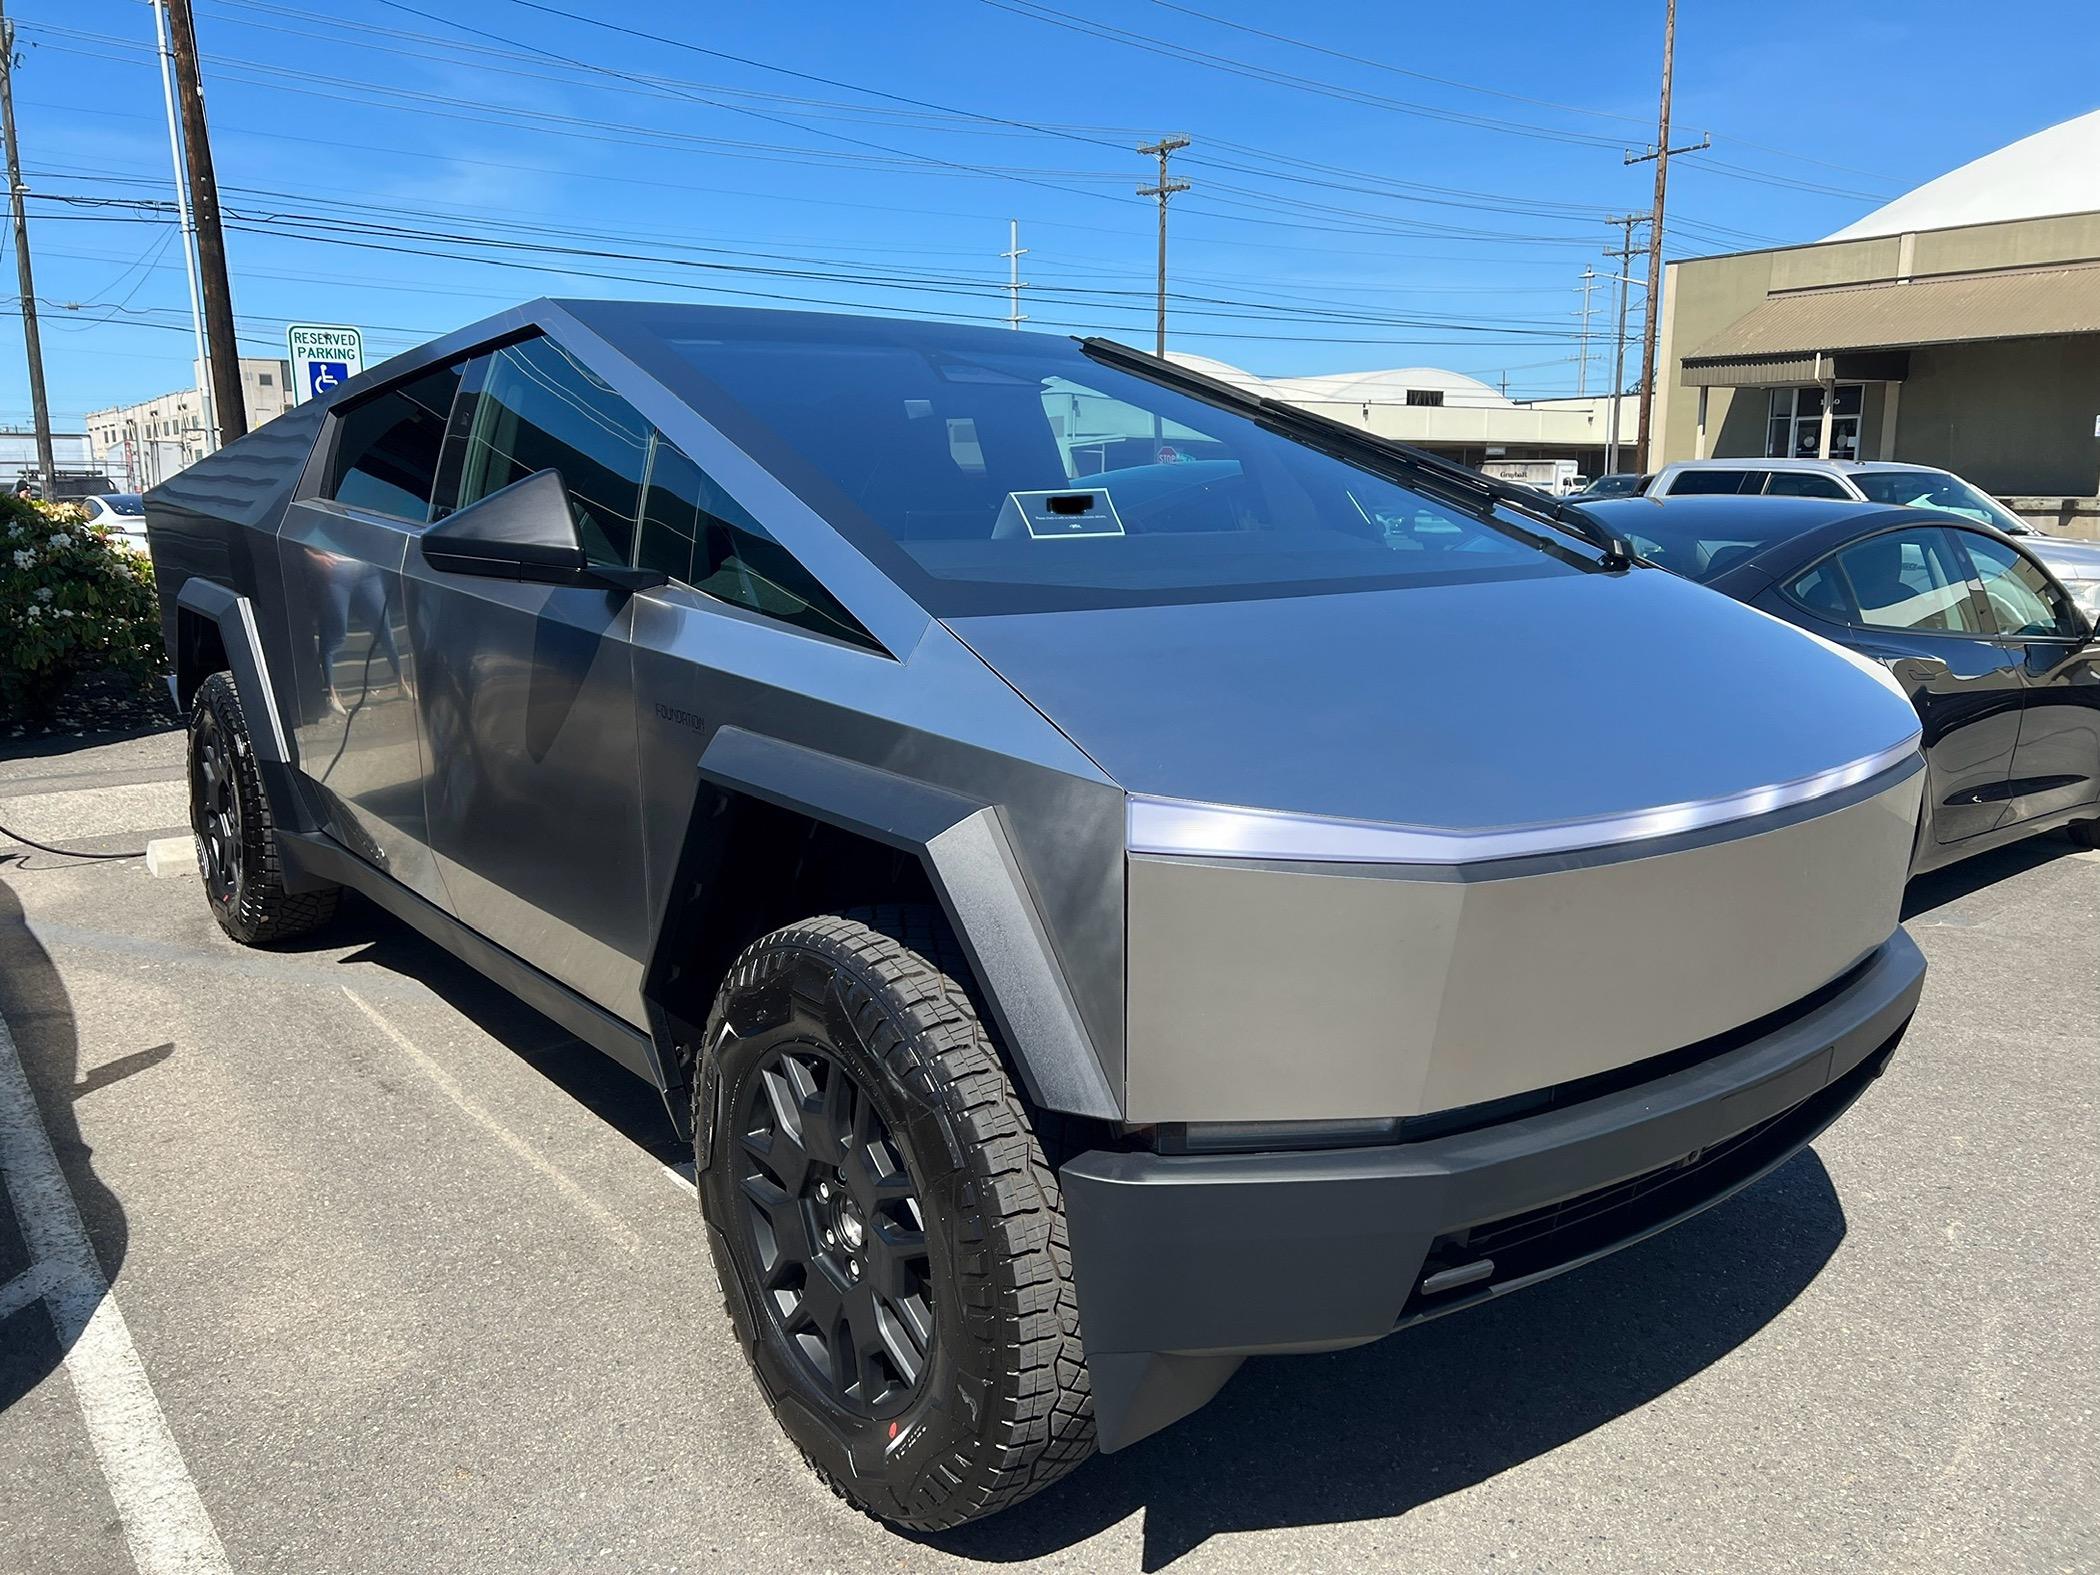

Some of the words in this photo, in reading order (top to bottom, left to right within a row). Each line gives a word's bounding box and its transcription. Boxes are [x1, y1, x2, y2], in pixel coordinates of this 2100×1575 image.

[294, 331, 356, 346] RESERVED
[297, 346, 355, 360] PARKING
[1159, 454, 1176, 464] STOP
[655, 703, 705, 732] FOUNDATION
